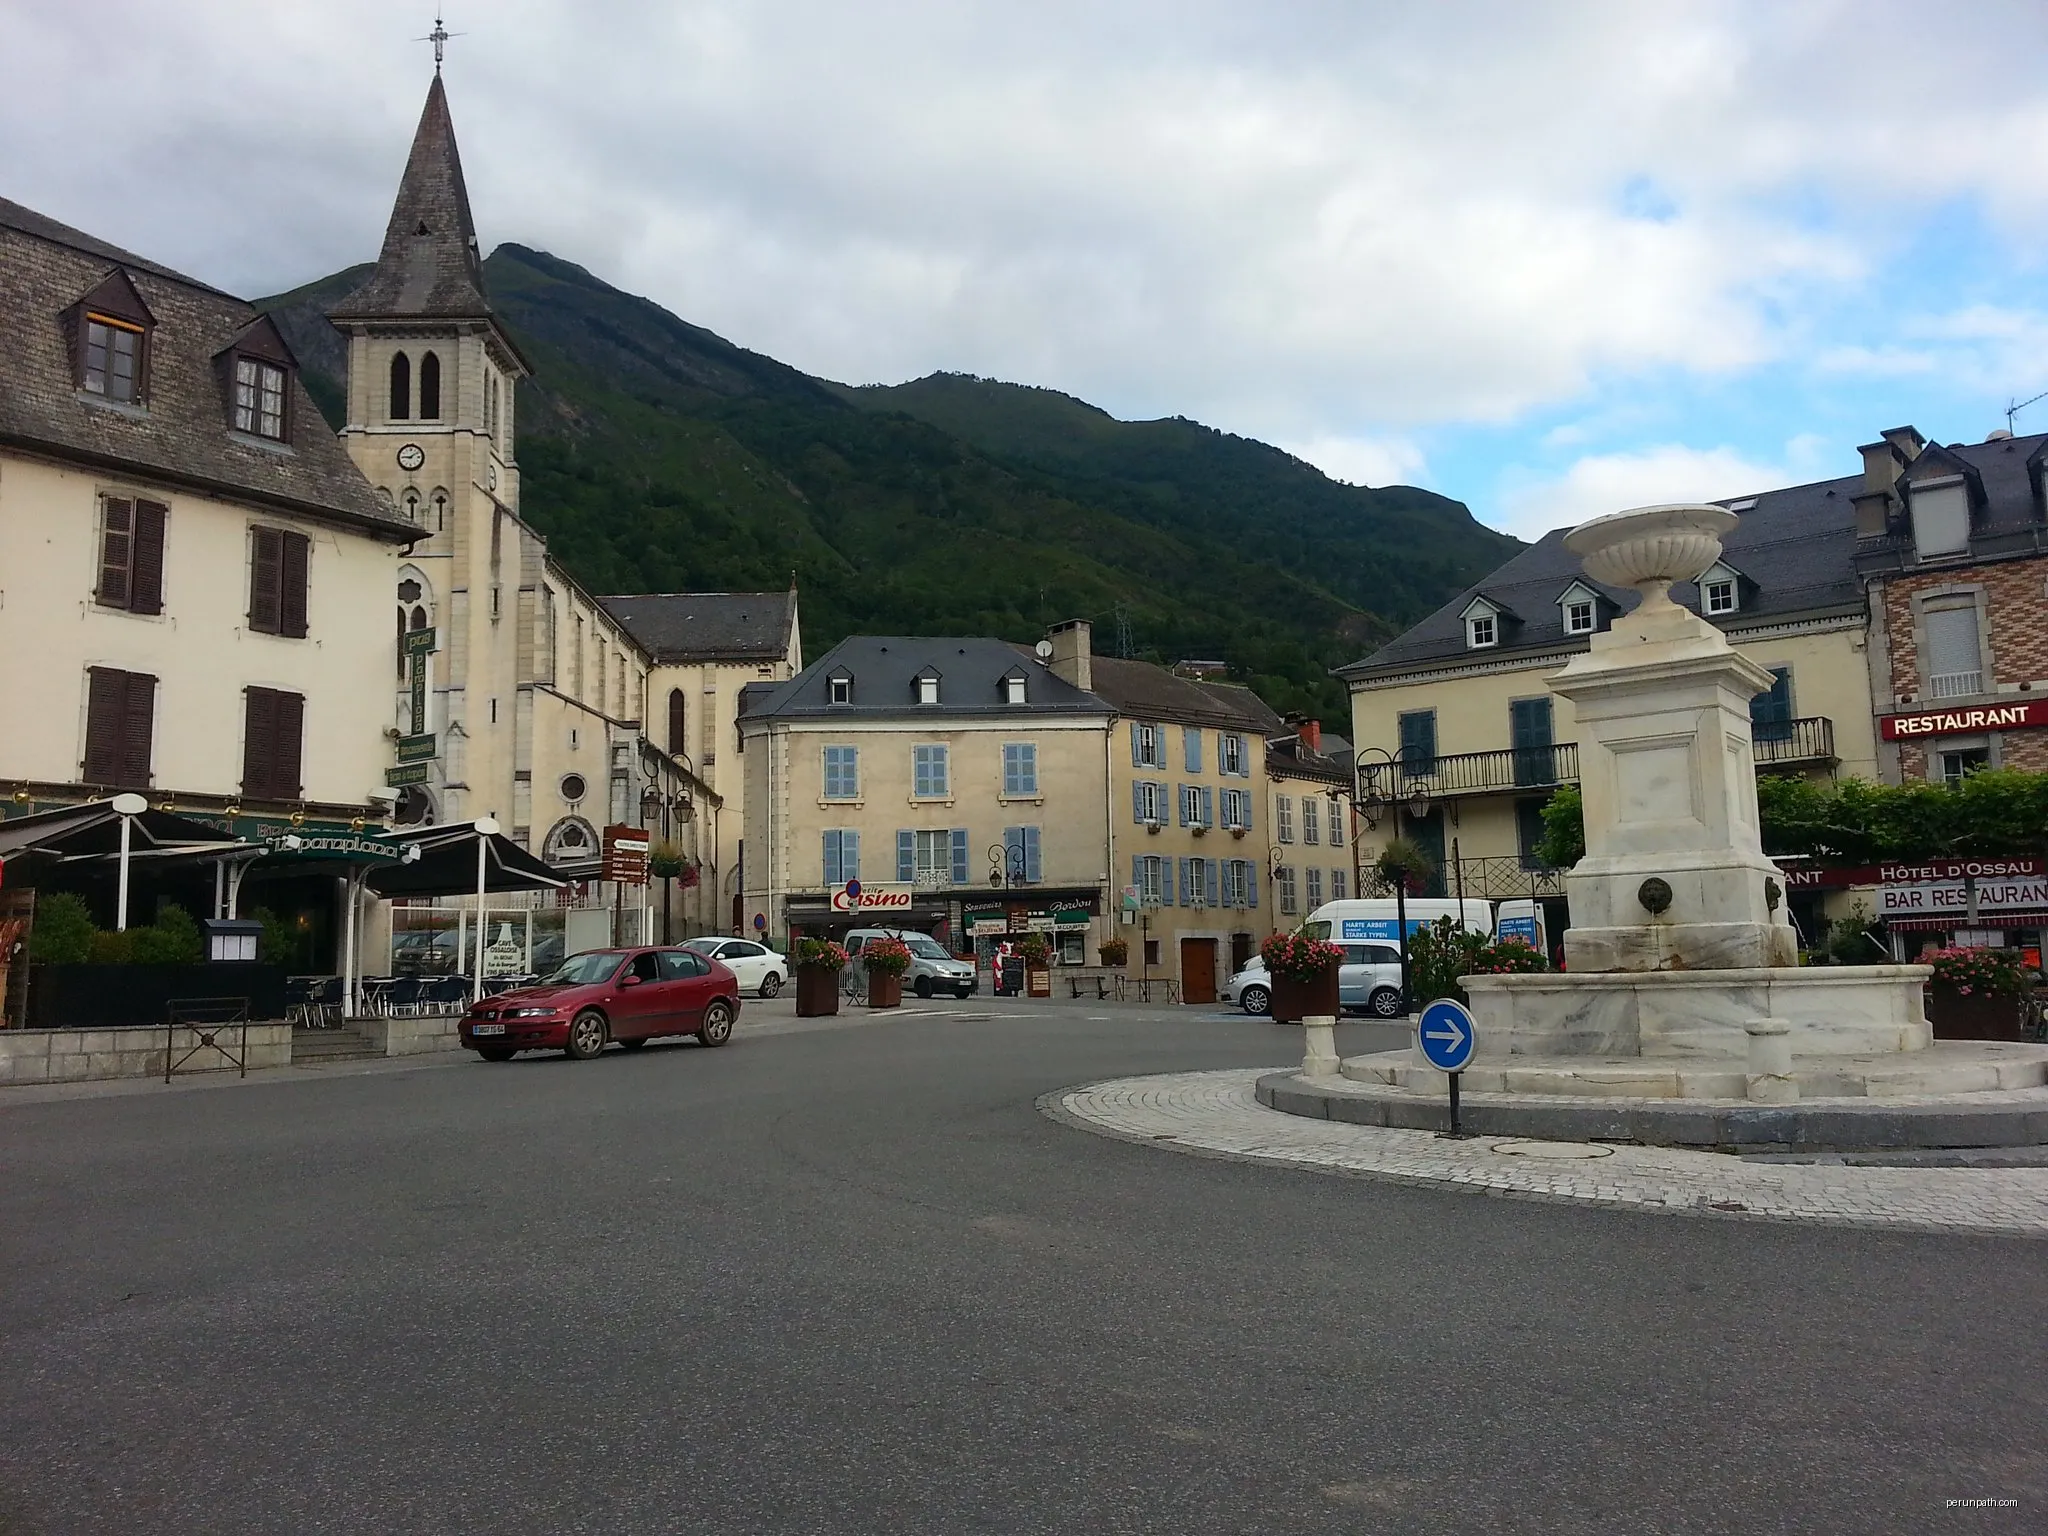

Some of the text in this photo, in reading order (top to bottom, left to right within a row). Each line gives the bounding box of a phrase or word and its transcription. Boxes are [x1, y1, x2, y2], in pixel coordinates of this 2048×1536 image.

[1894, 706, 2029, 735] RESTAURANT
[1784, 871, 1824, 884] ANT
[1880, 861, 2033, 880] HÔTEL D'OSSAU
[860, 886, 879, 895] etit
[1884, 884, 2048, 909] BAR RESAURAN
[964, 901, 1002, 912] Souvenirs
